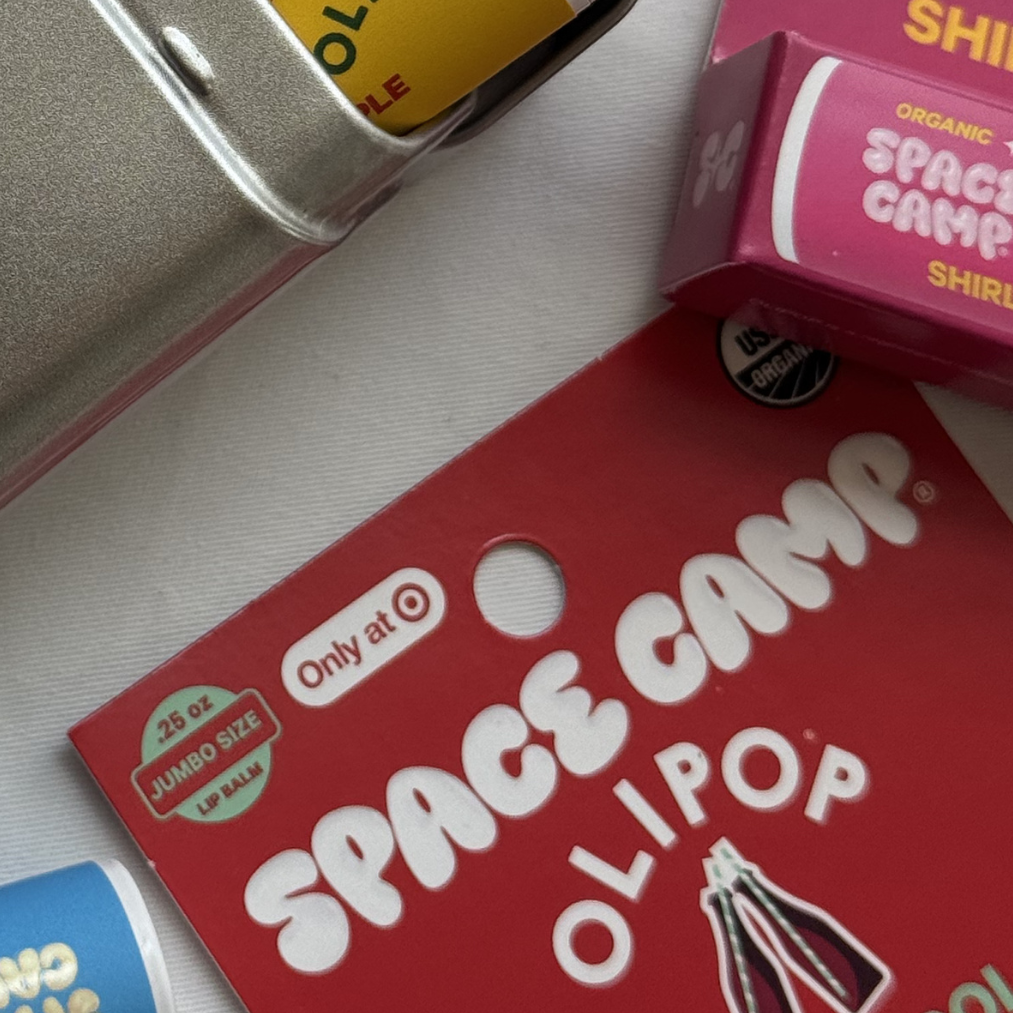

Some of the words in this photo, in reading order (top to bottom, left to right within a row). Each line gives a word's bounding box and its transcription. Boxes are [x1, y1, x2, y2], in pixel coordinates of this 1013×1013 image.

[896, 102, 994, 145] ORGANIC
[862, 180, 1013, 261] CAMP
[296, 644, 363, 688] Only
[367, 611, 396, 645] at
[157, 710, 186, 744] .25
[188, 694, 214, 719] oz
[244, 649, 630, 973] SPACE
[614, 433, 918, 704] CAMP
[151, 742, 217, 800] JUMBO
[215, 709, 263, 750] SIZE
[196, 792, 220, 816] LIP
[220, 761, 264, 798] BALM
[552, 726, 868, 986] OLIPOP
